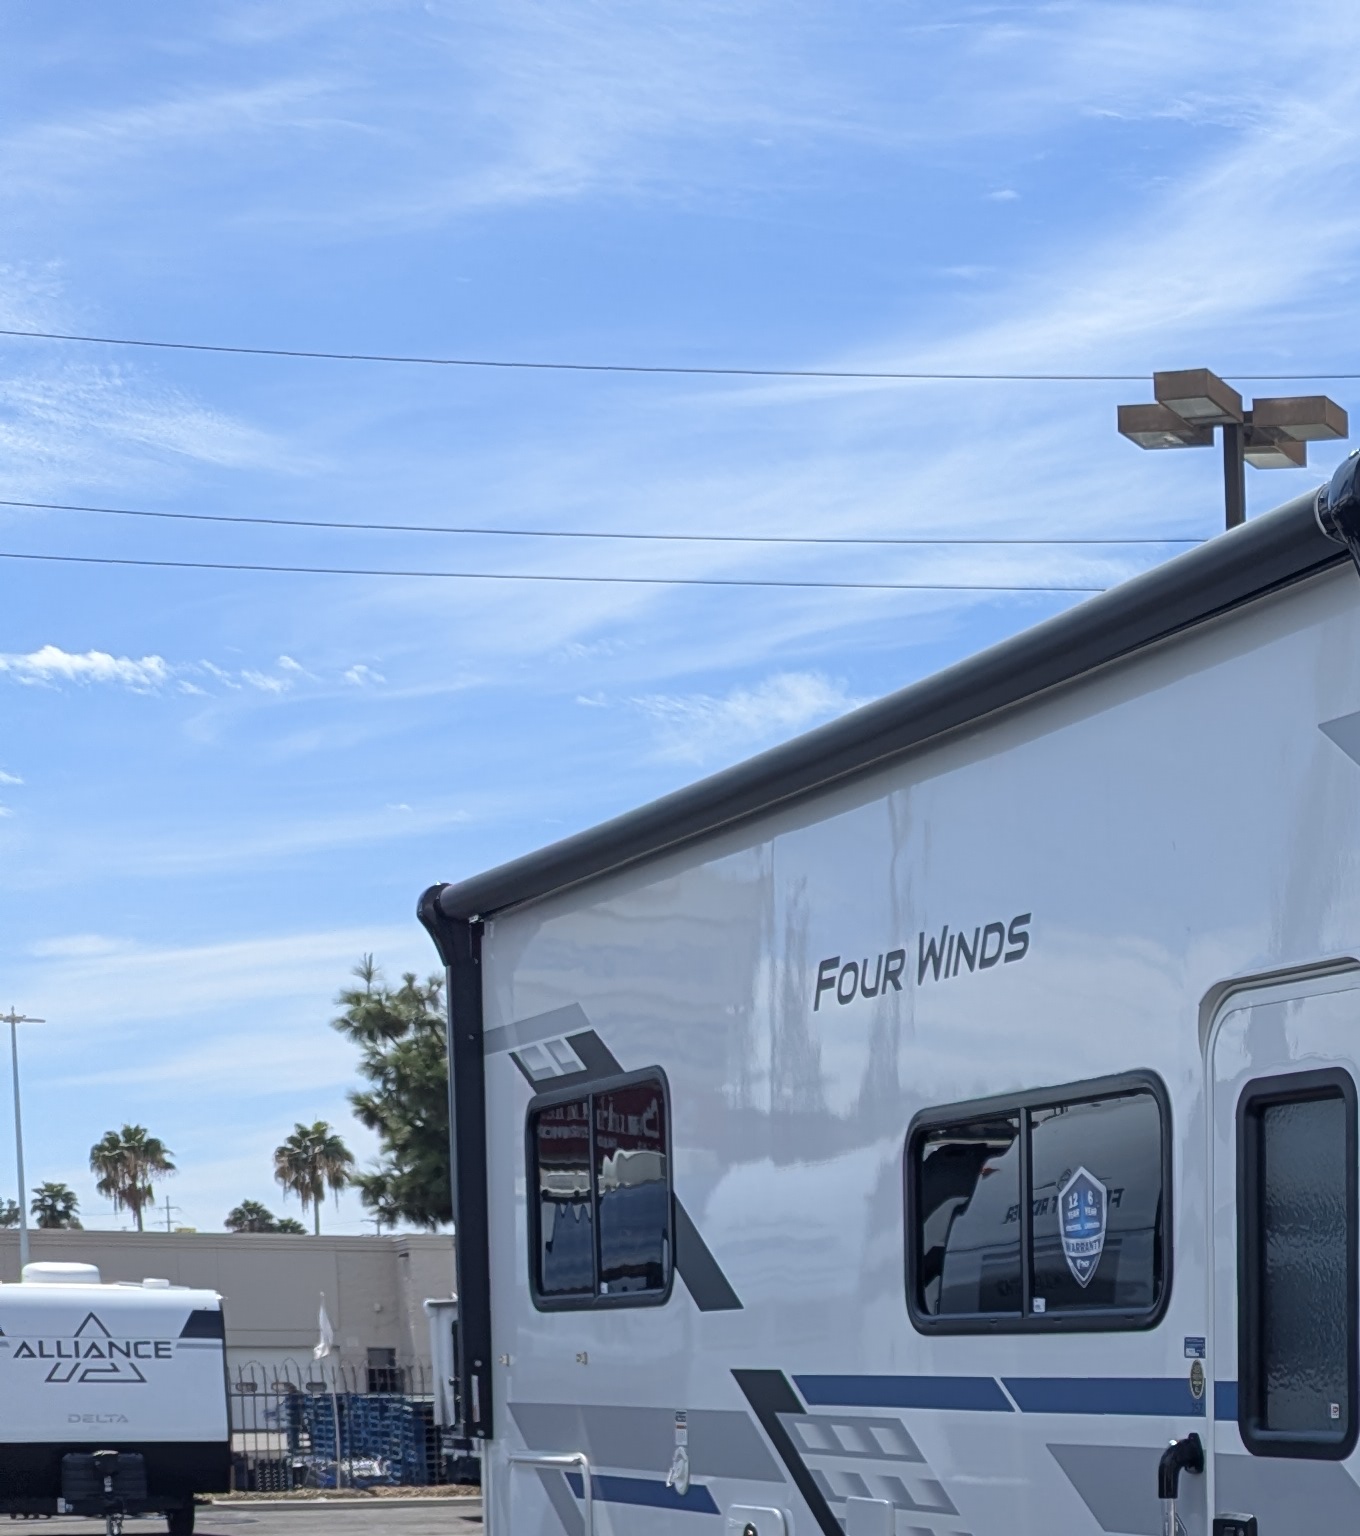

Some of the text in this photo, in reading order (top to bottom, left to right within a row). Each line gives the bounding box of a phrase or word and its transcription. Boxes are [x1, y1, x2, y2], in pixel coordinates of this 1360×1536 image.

[813, 912, 1032, 1012] FOUR WINDS
[1068, 1192, 1079, 1209] 12
[1087, 1190, 1094, 1205] 6
[12, 1340, 173, 1359] ALLIANCE
[67, 1413, 129, 1424] DELTA
